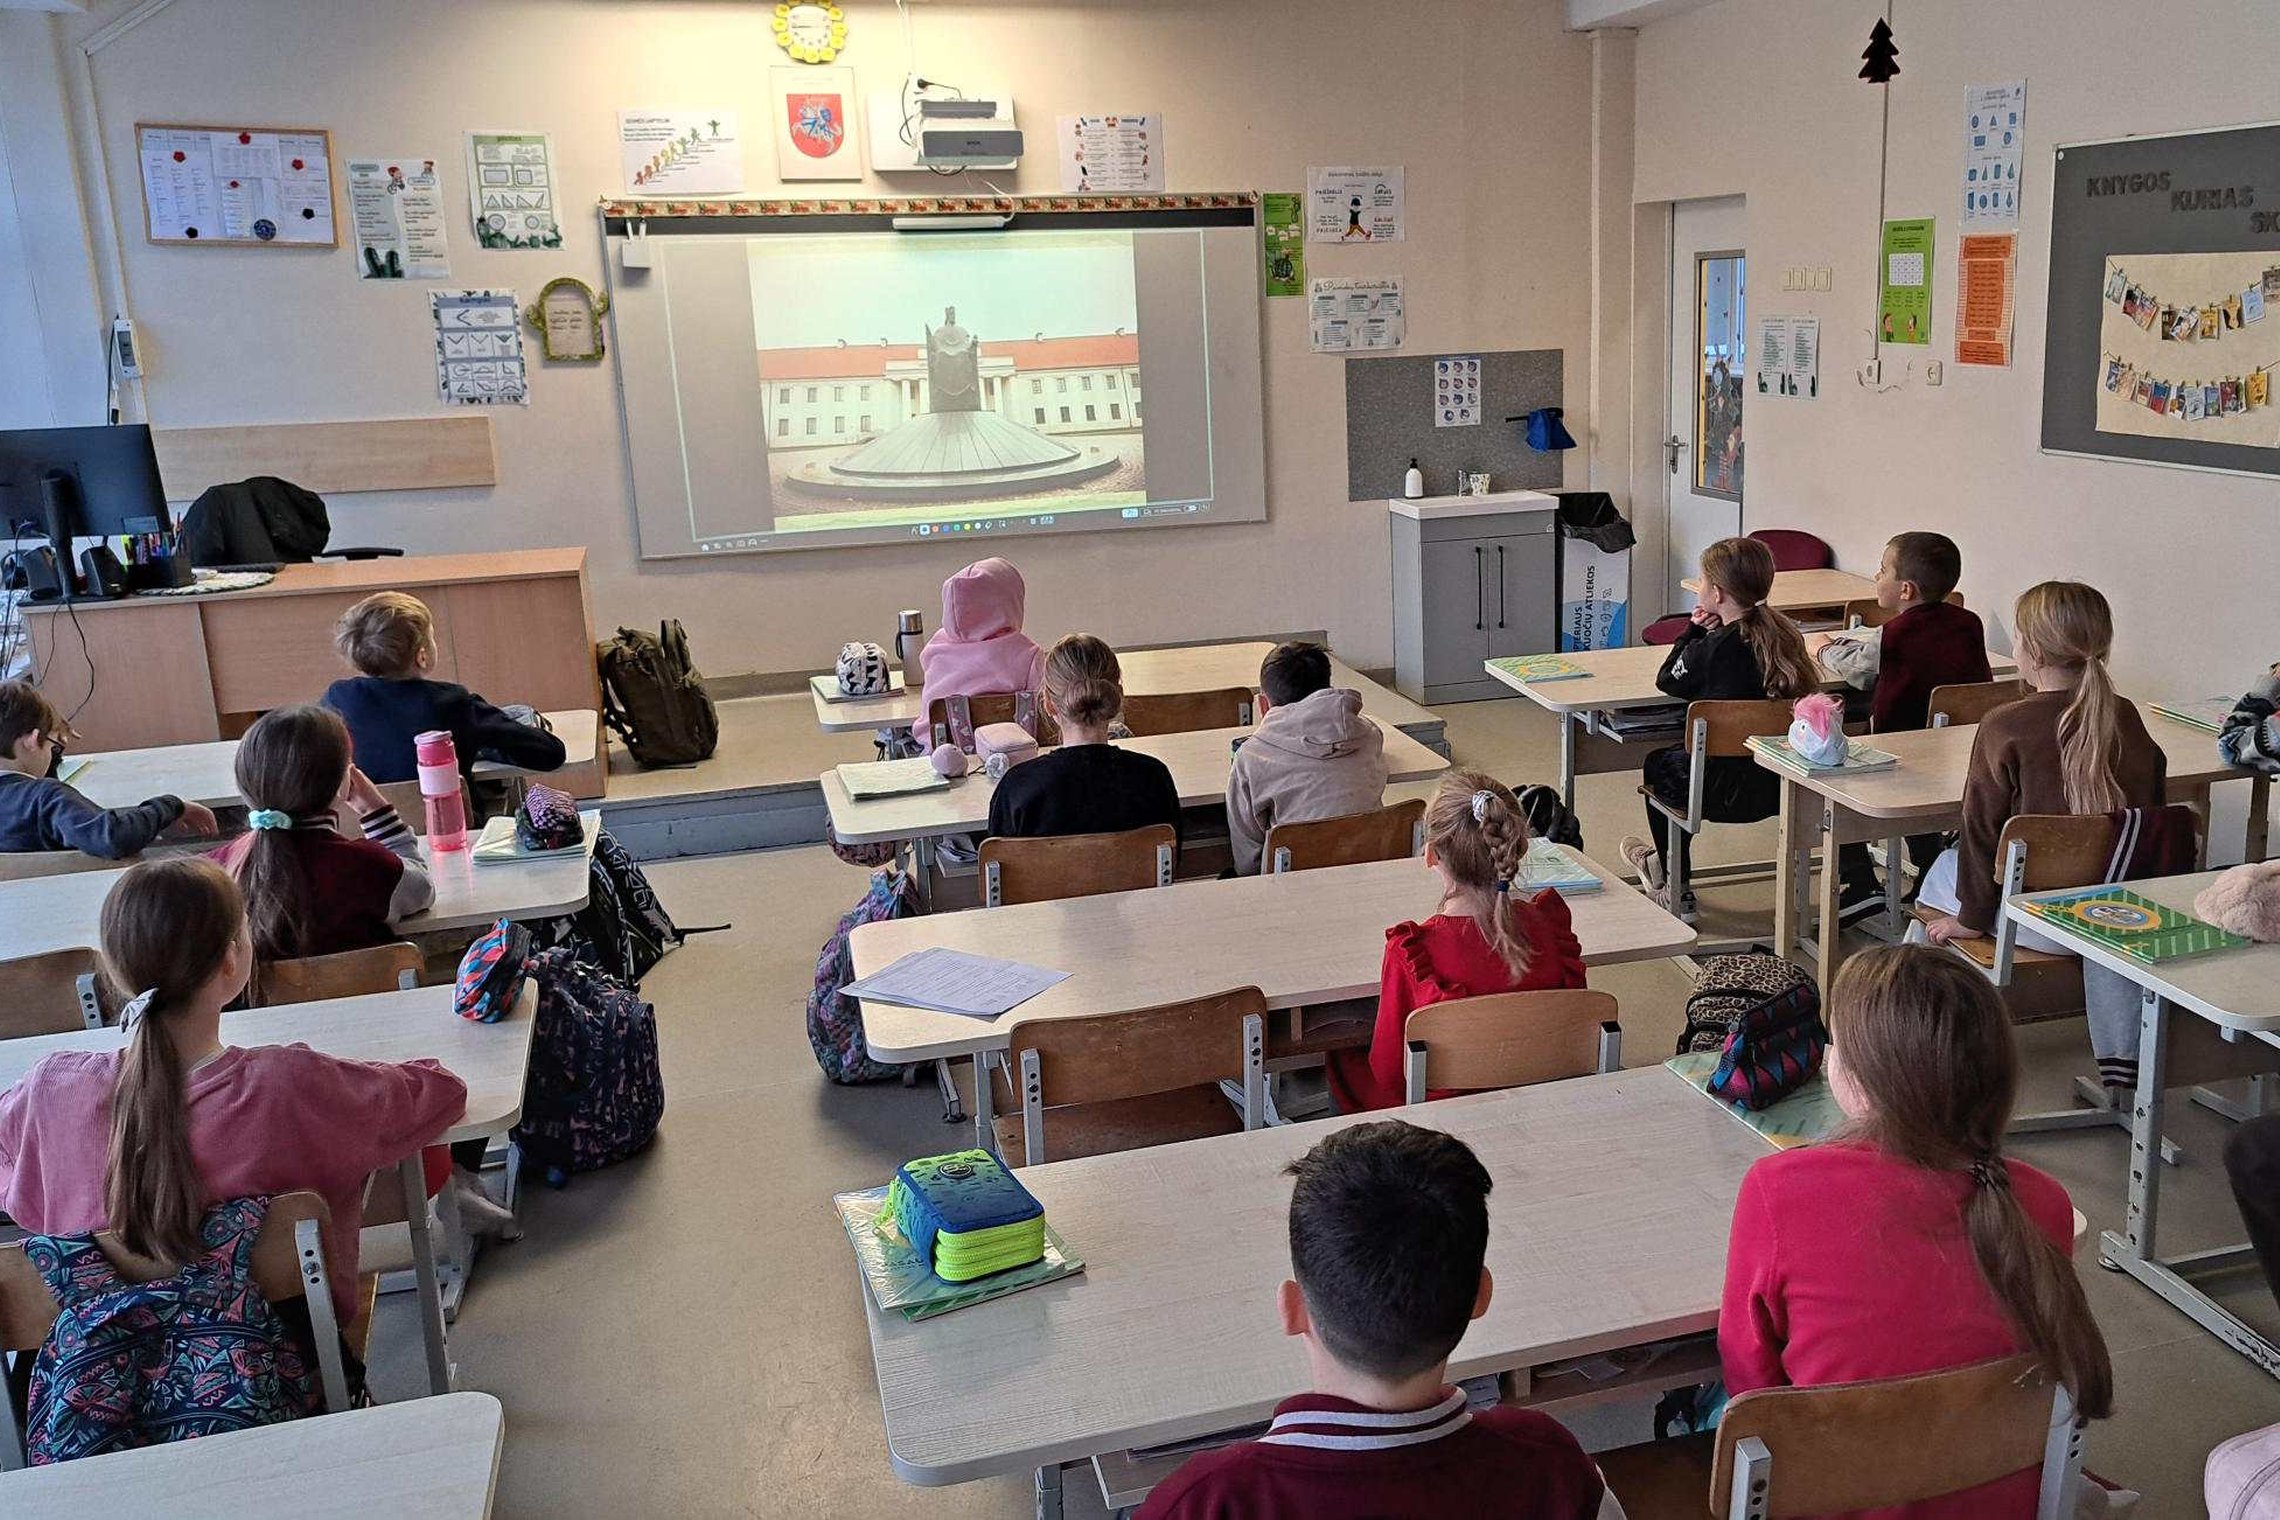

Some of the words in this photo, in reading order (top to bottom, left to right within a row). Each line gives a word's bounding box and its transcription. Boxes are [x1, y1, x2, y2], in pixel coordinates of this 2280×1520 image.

[2086, 171, 2171, 198] KNYGOS
[2171, 185, 2254, 213] KURIAS
[1585, 565, 1595, 611] ATLIEKOS
